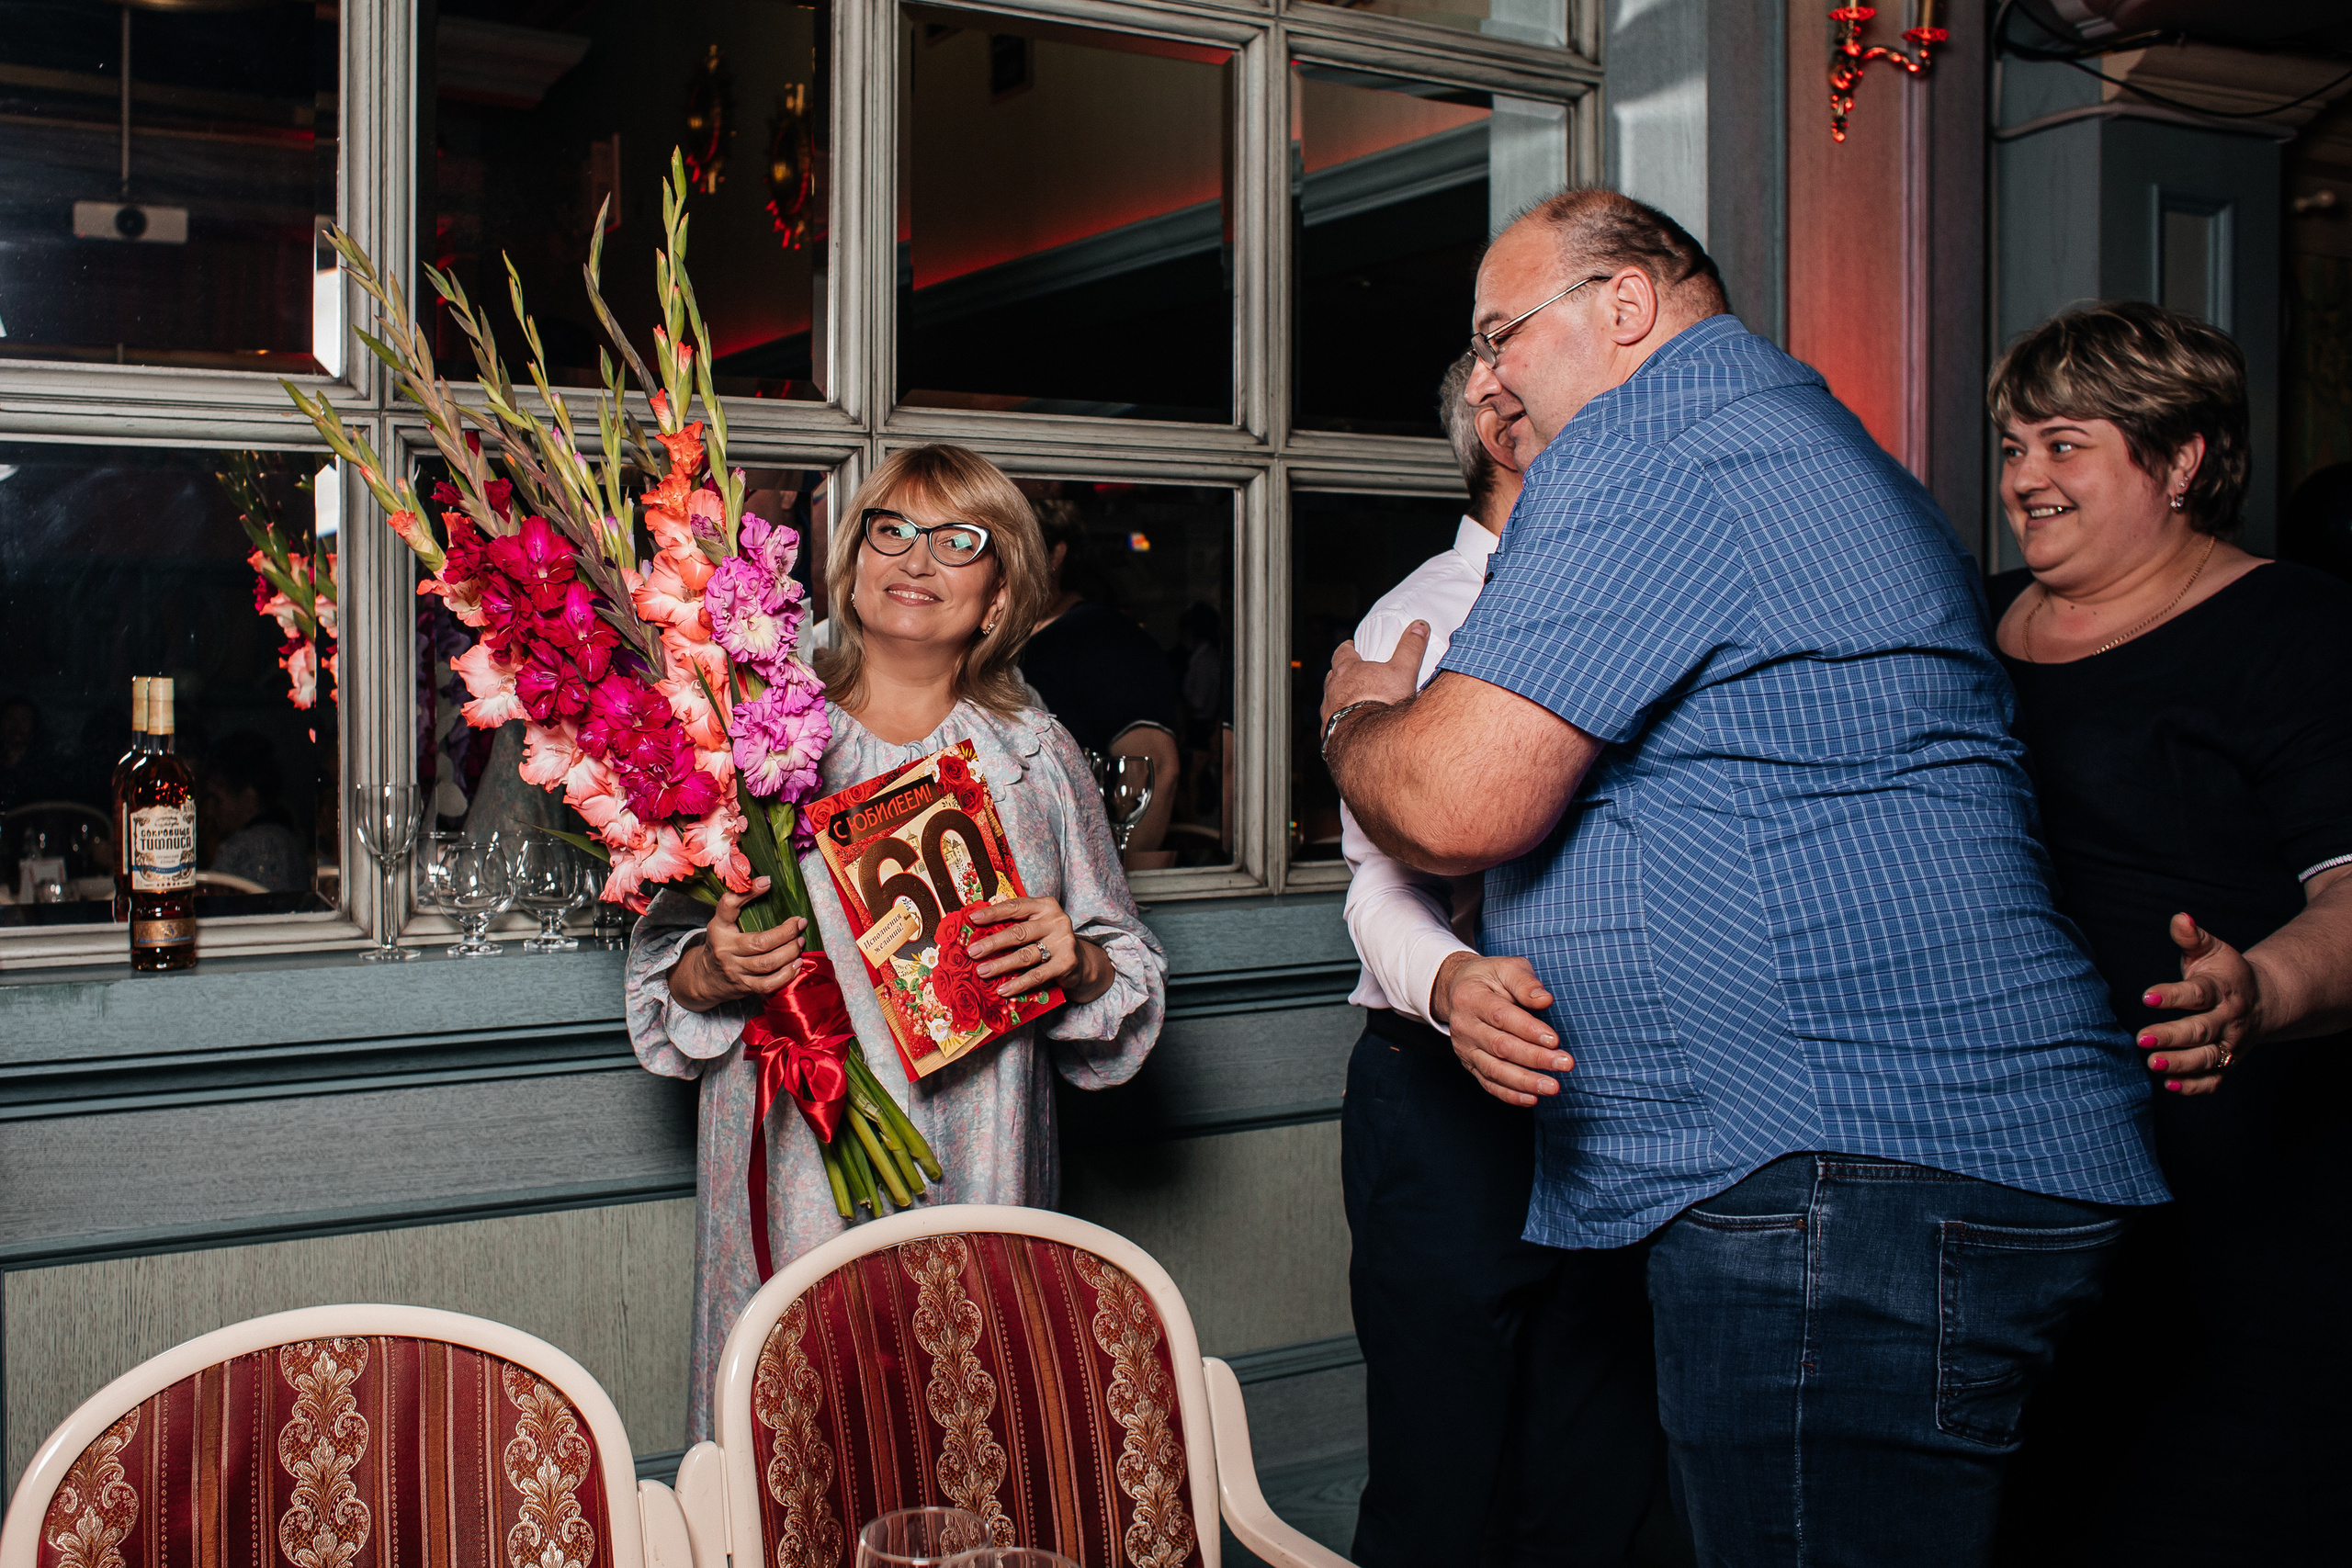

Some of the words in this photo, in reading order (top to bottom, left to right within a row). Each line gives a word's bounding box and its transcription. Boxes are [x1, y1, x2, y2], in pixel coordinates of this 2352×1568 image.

[833, 820, 848, 839] С
[846, 784, 933, 836] ЮБИЛЕЕМ!
[140, 836, 191, 851] ТИФЛИСА
[141, 827, 190, 838] СОКРОВИЩЕ
[859, 809, 999, 961] 60
[864, 913, 902, 950] Исполнения
[874, 922, 904, 954] желаний!
